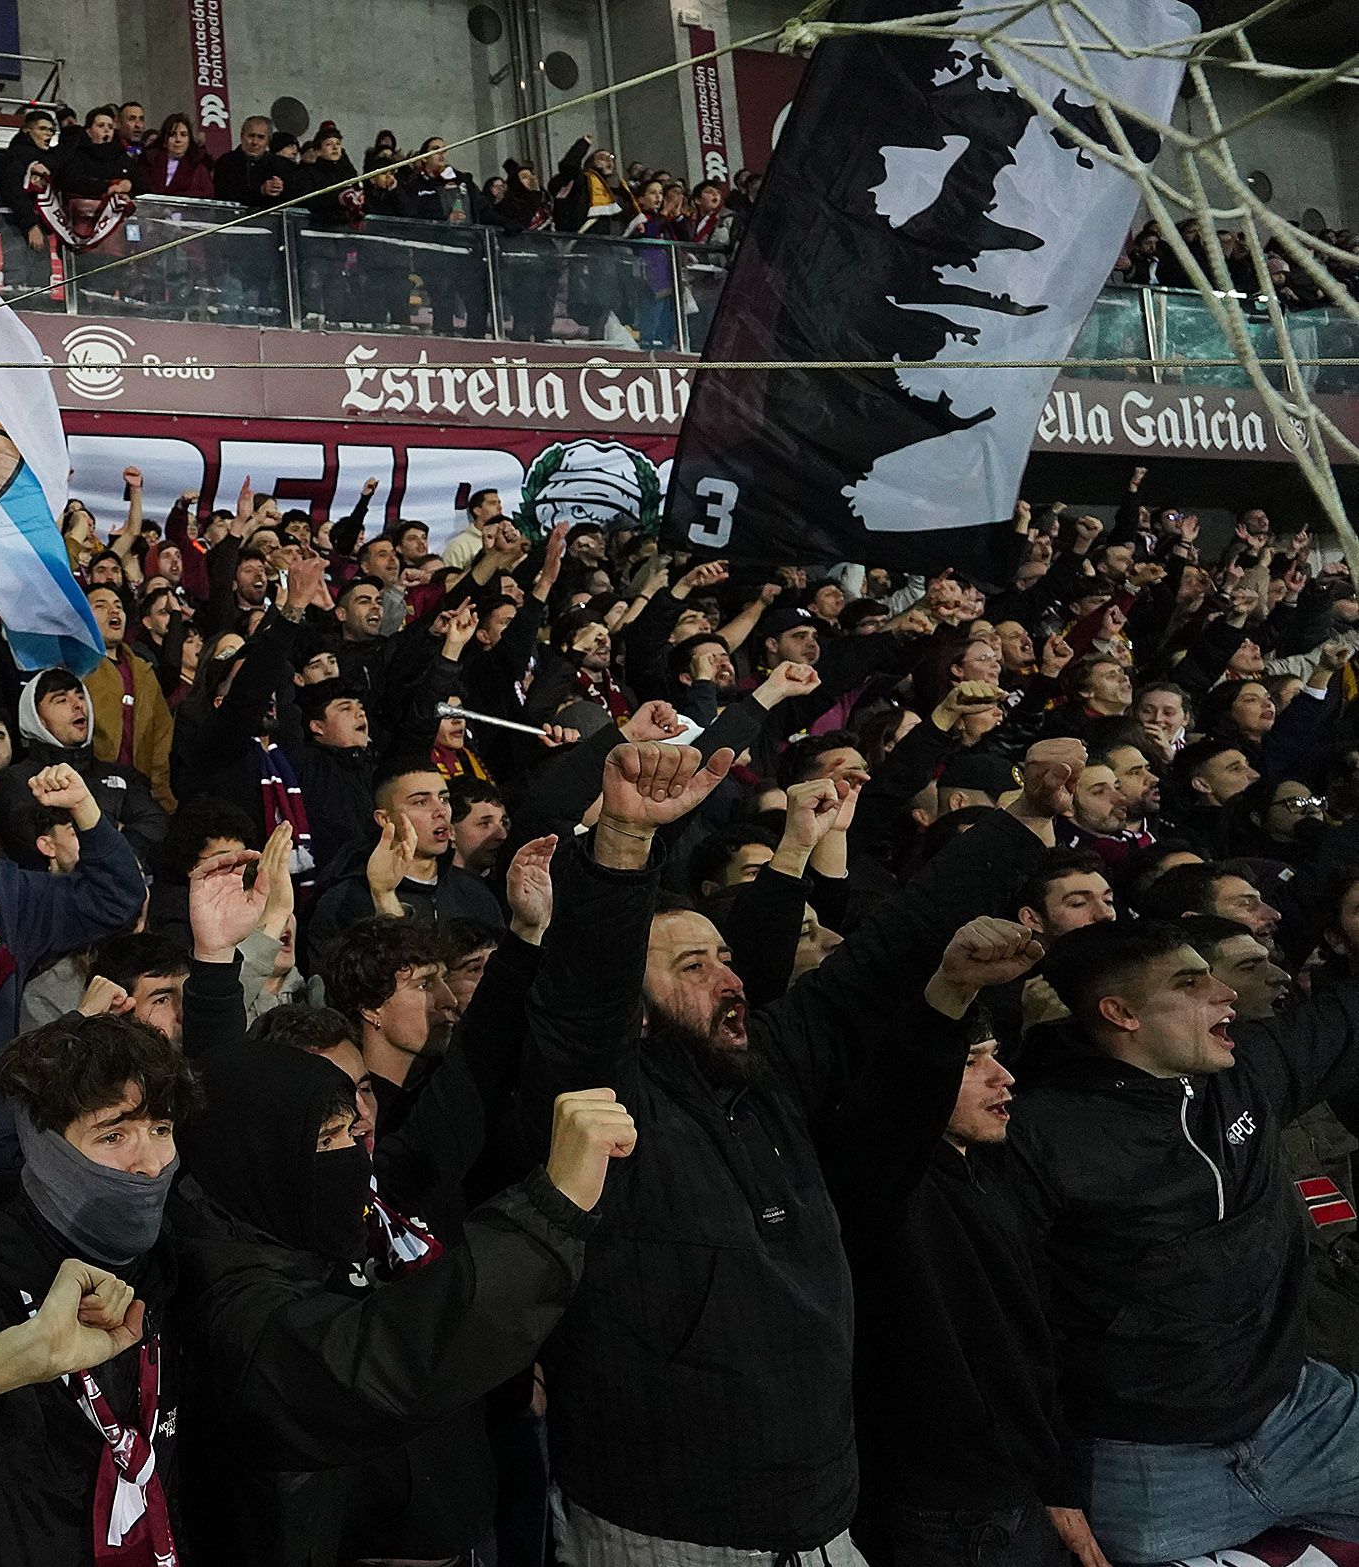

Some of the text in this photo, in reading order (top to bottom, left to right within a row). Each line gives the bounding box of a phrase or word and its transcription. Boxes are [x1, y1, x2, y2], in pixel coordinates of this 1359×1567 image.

[707, 67, 723, 146] Pontevedra
[143, 354, 216, 380] Radio
[342, 344, 570, 419] Estrella
[1121, 390, 1267, 452] Galicia
[688, 476, 739, 548] 3
[1231, 1110, 1257, 1142] PCF
